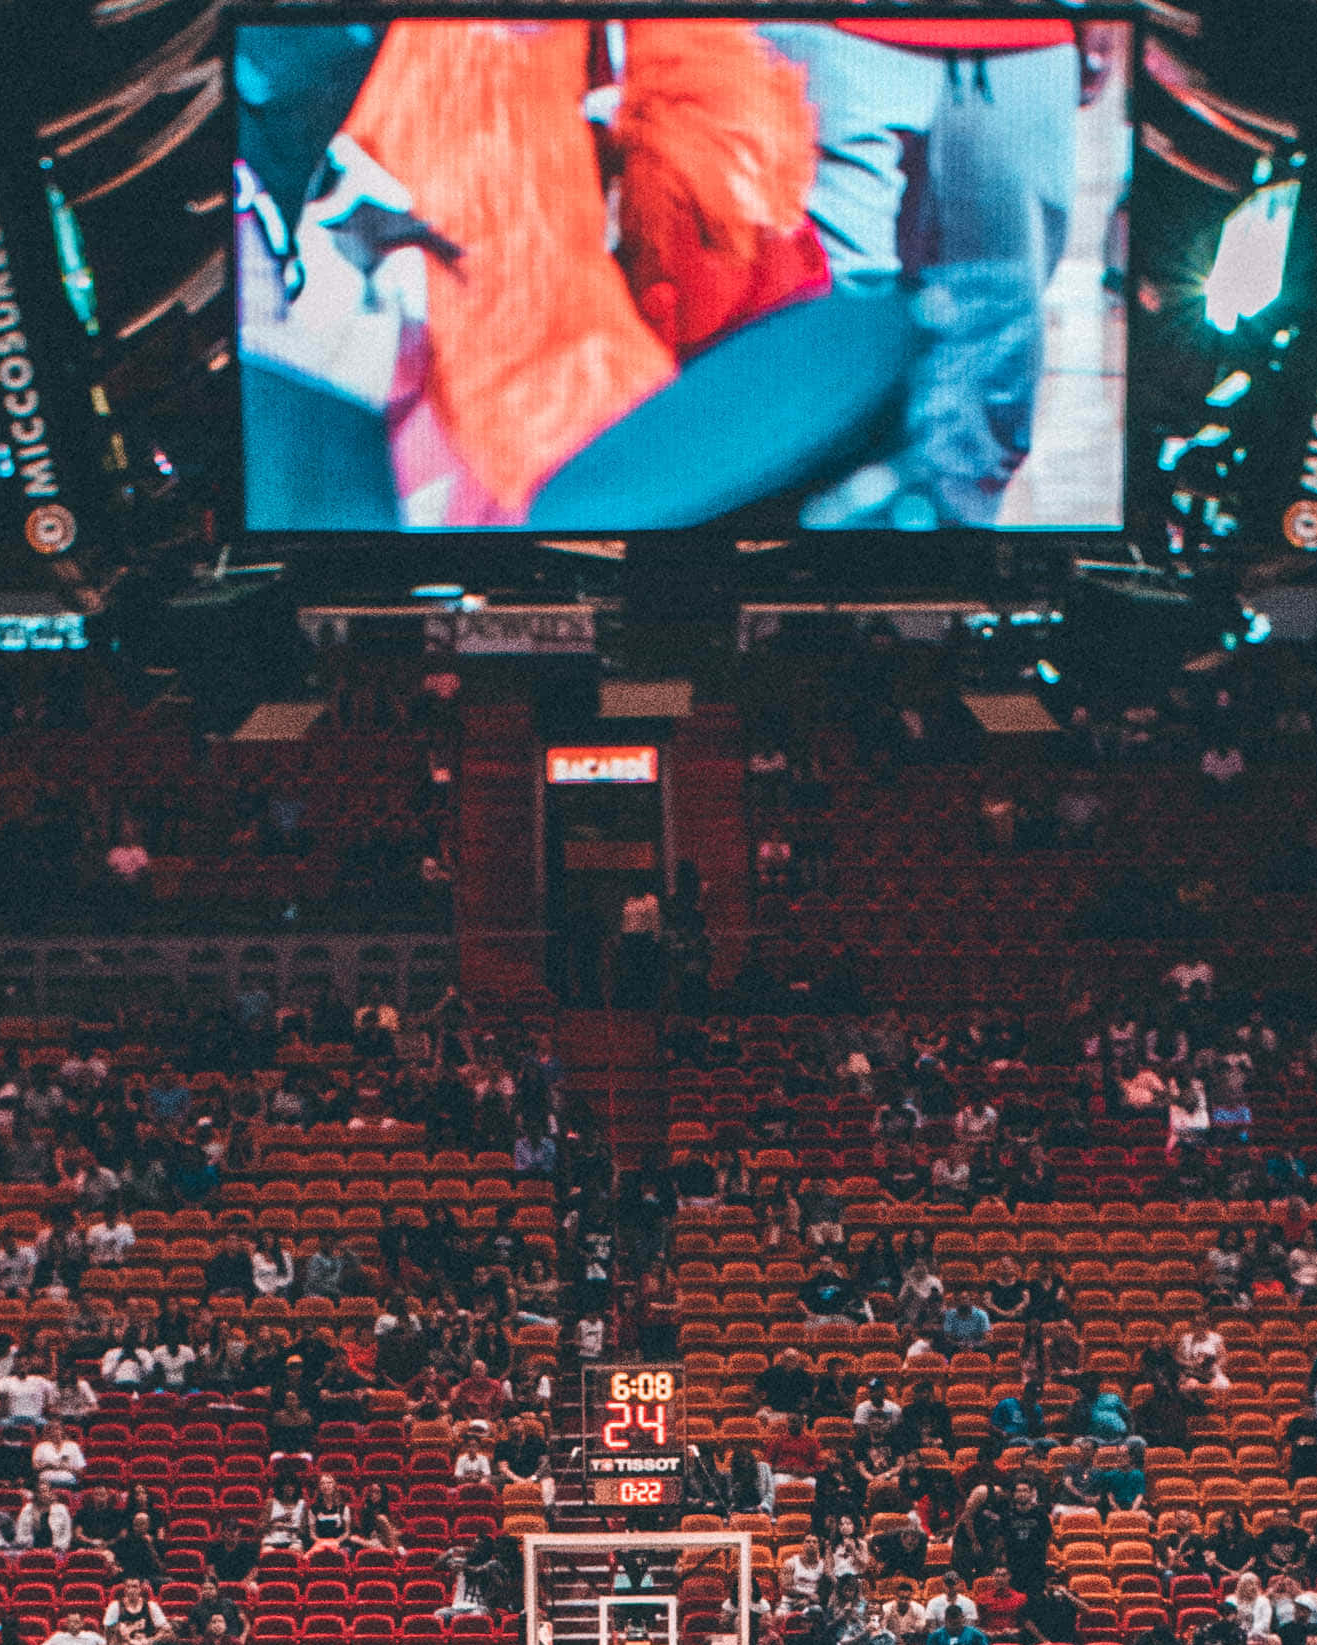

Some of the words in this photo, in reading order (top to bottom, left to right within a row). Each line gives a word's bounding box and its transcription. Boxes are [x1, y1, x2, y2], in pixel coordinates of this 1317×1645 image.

[610, 1370, 675, 1402] 6:08
[603, 1401, 667, 1450] 24
[614, 1457, 681, 1473] TISSOT
[619, 1480, 663, 1504] 0:22
